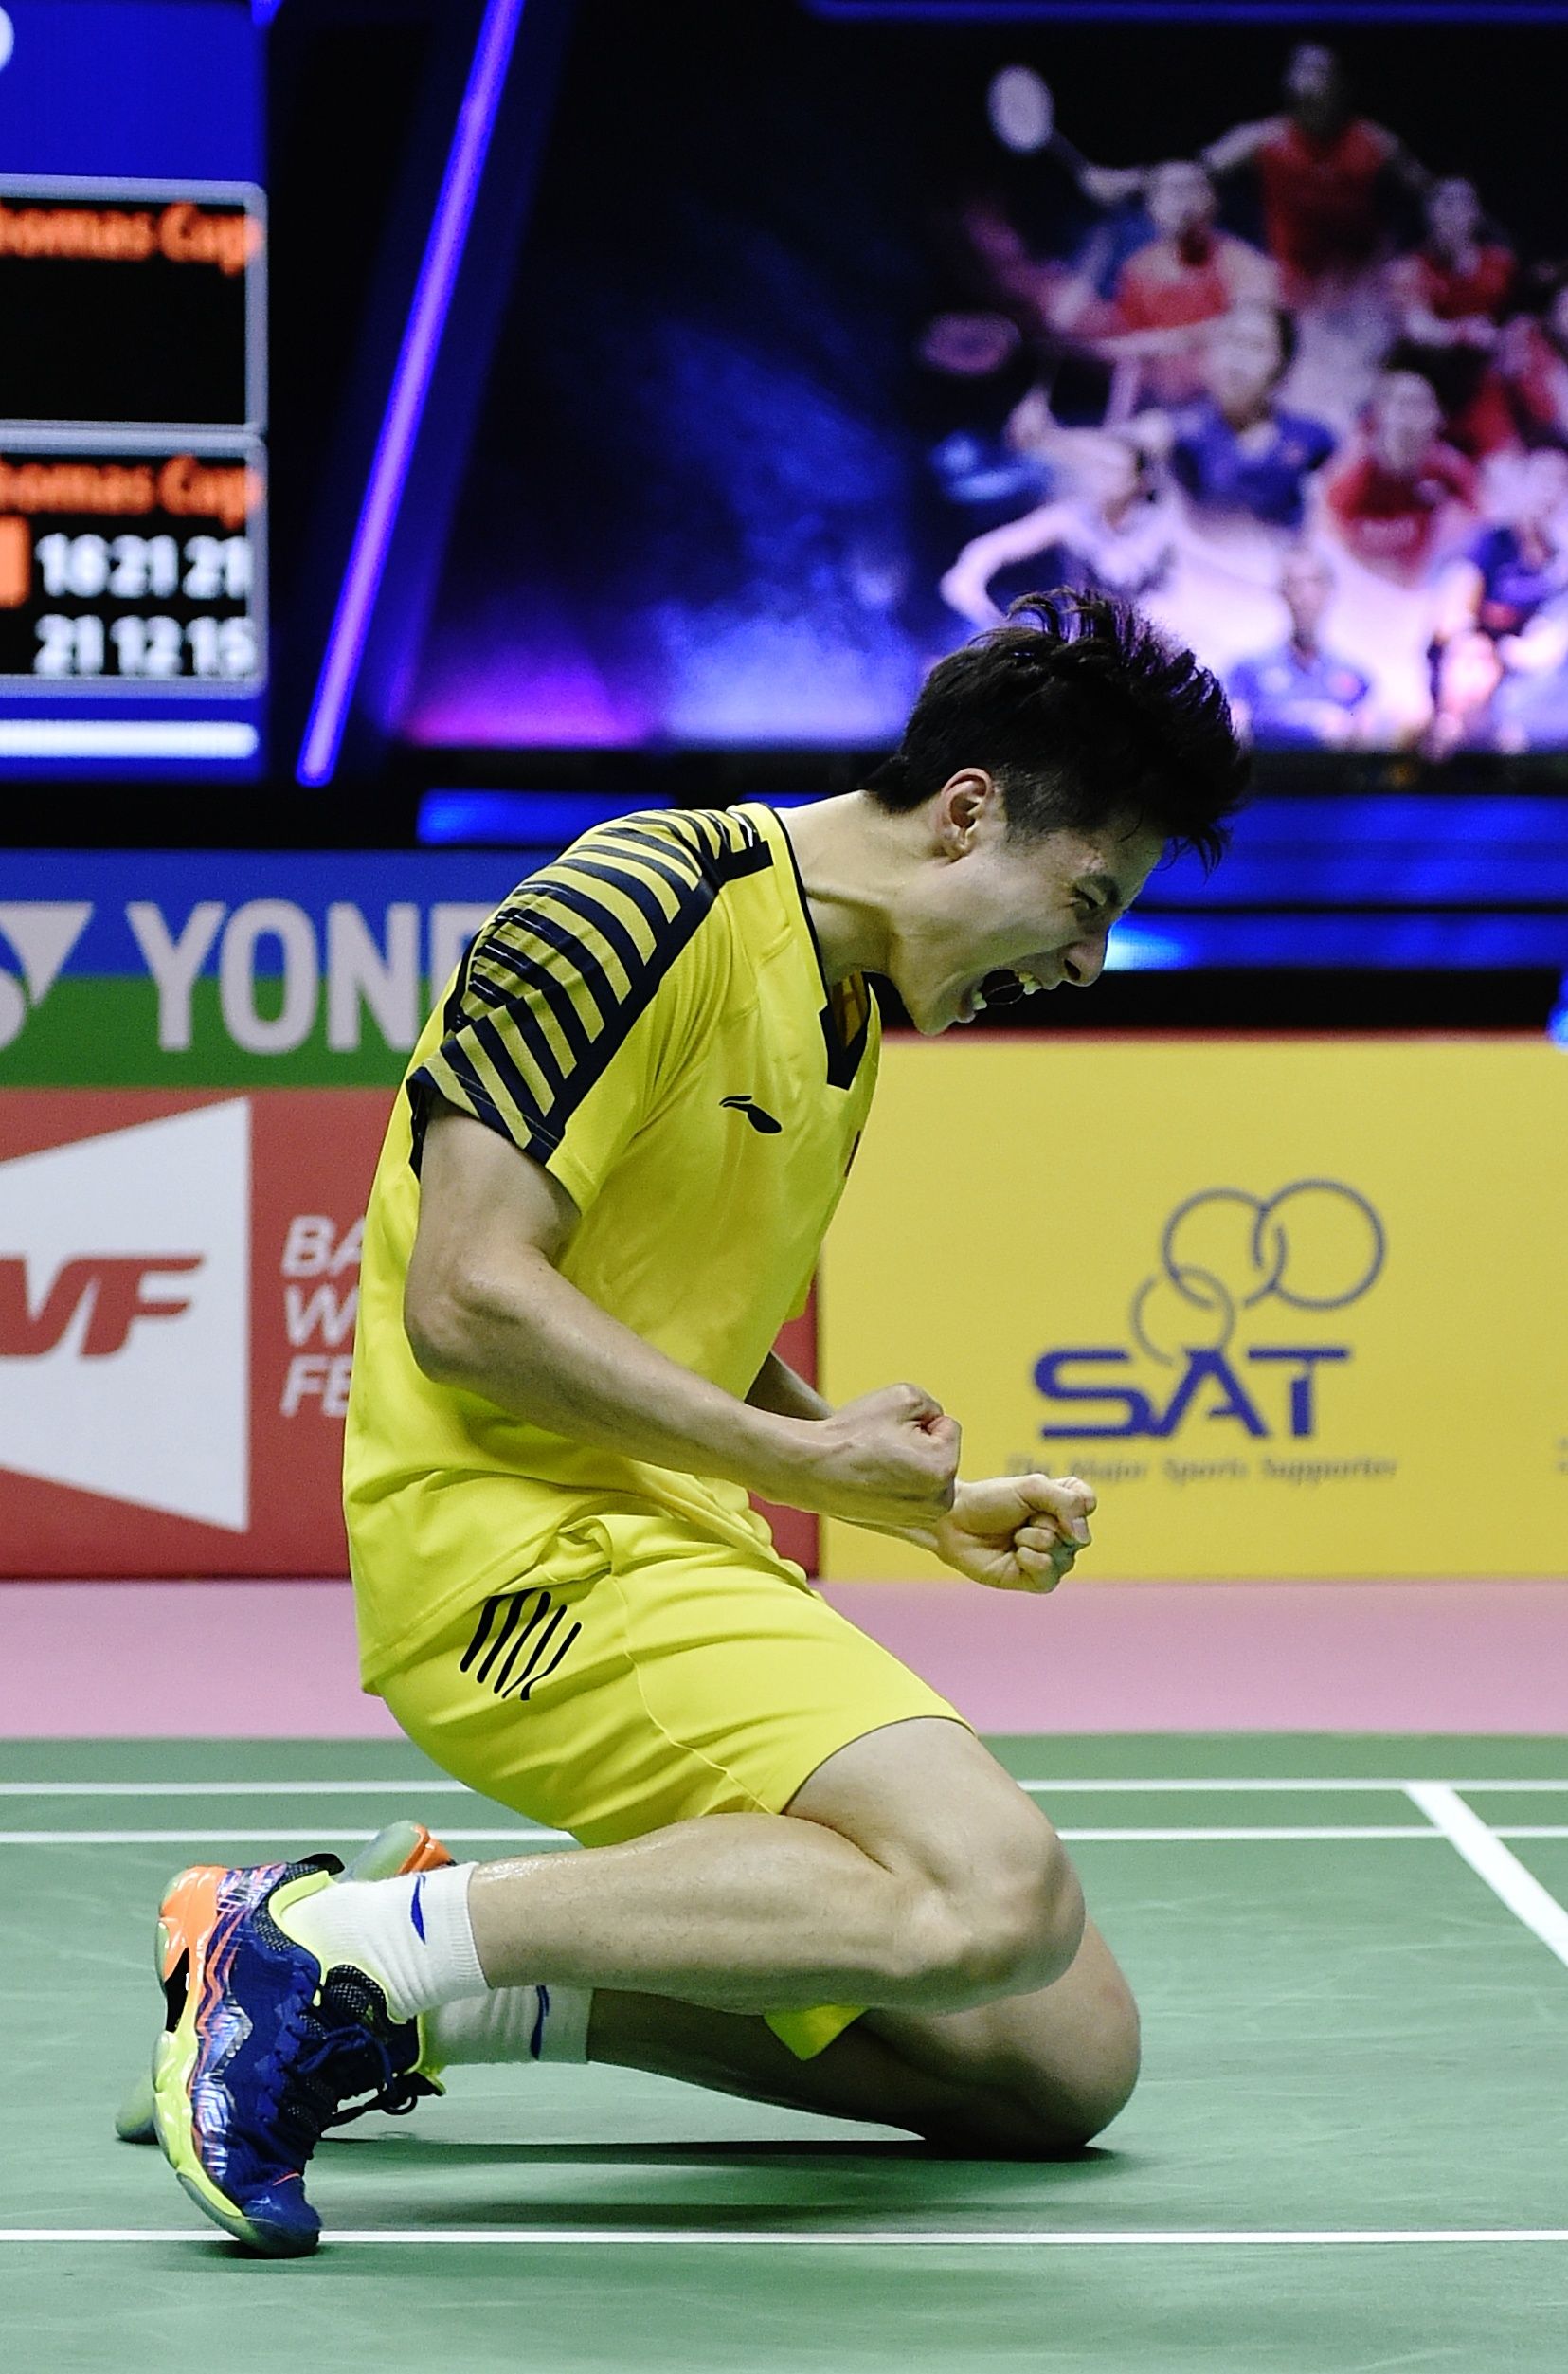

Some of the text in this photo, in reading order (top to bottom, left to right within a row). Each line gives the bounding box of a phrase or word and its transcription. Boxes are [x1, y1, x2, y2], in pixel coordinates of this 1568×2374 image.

[159, 200, 261, 276] Cup
[159, 454, 261, 531] Cup
[109, 535, 179, 599] 21
[184, 535, 253, 600] 21
[34, 614, 105, 675] 21
[110, 615, 182, 675] 12
[1032, 1347, 1349, 1438] SAT
[1263, 1457, 1397, 1487] Supporter
